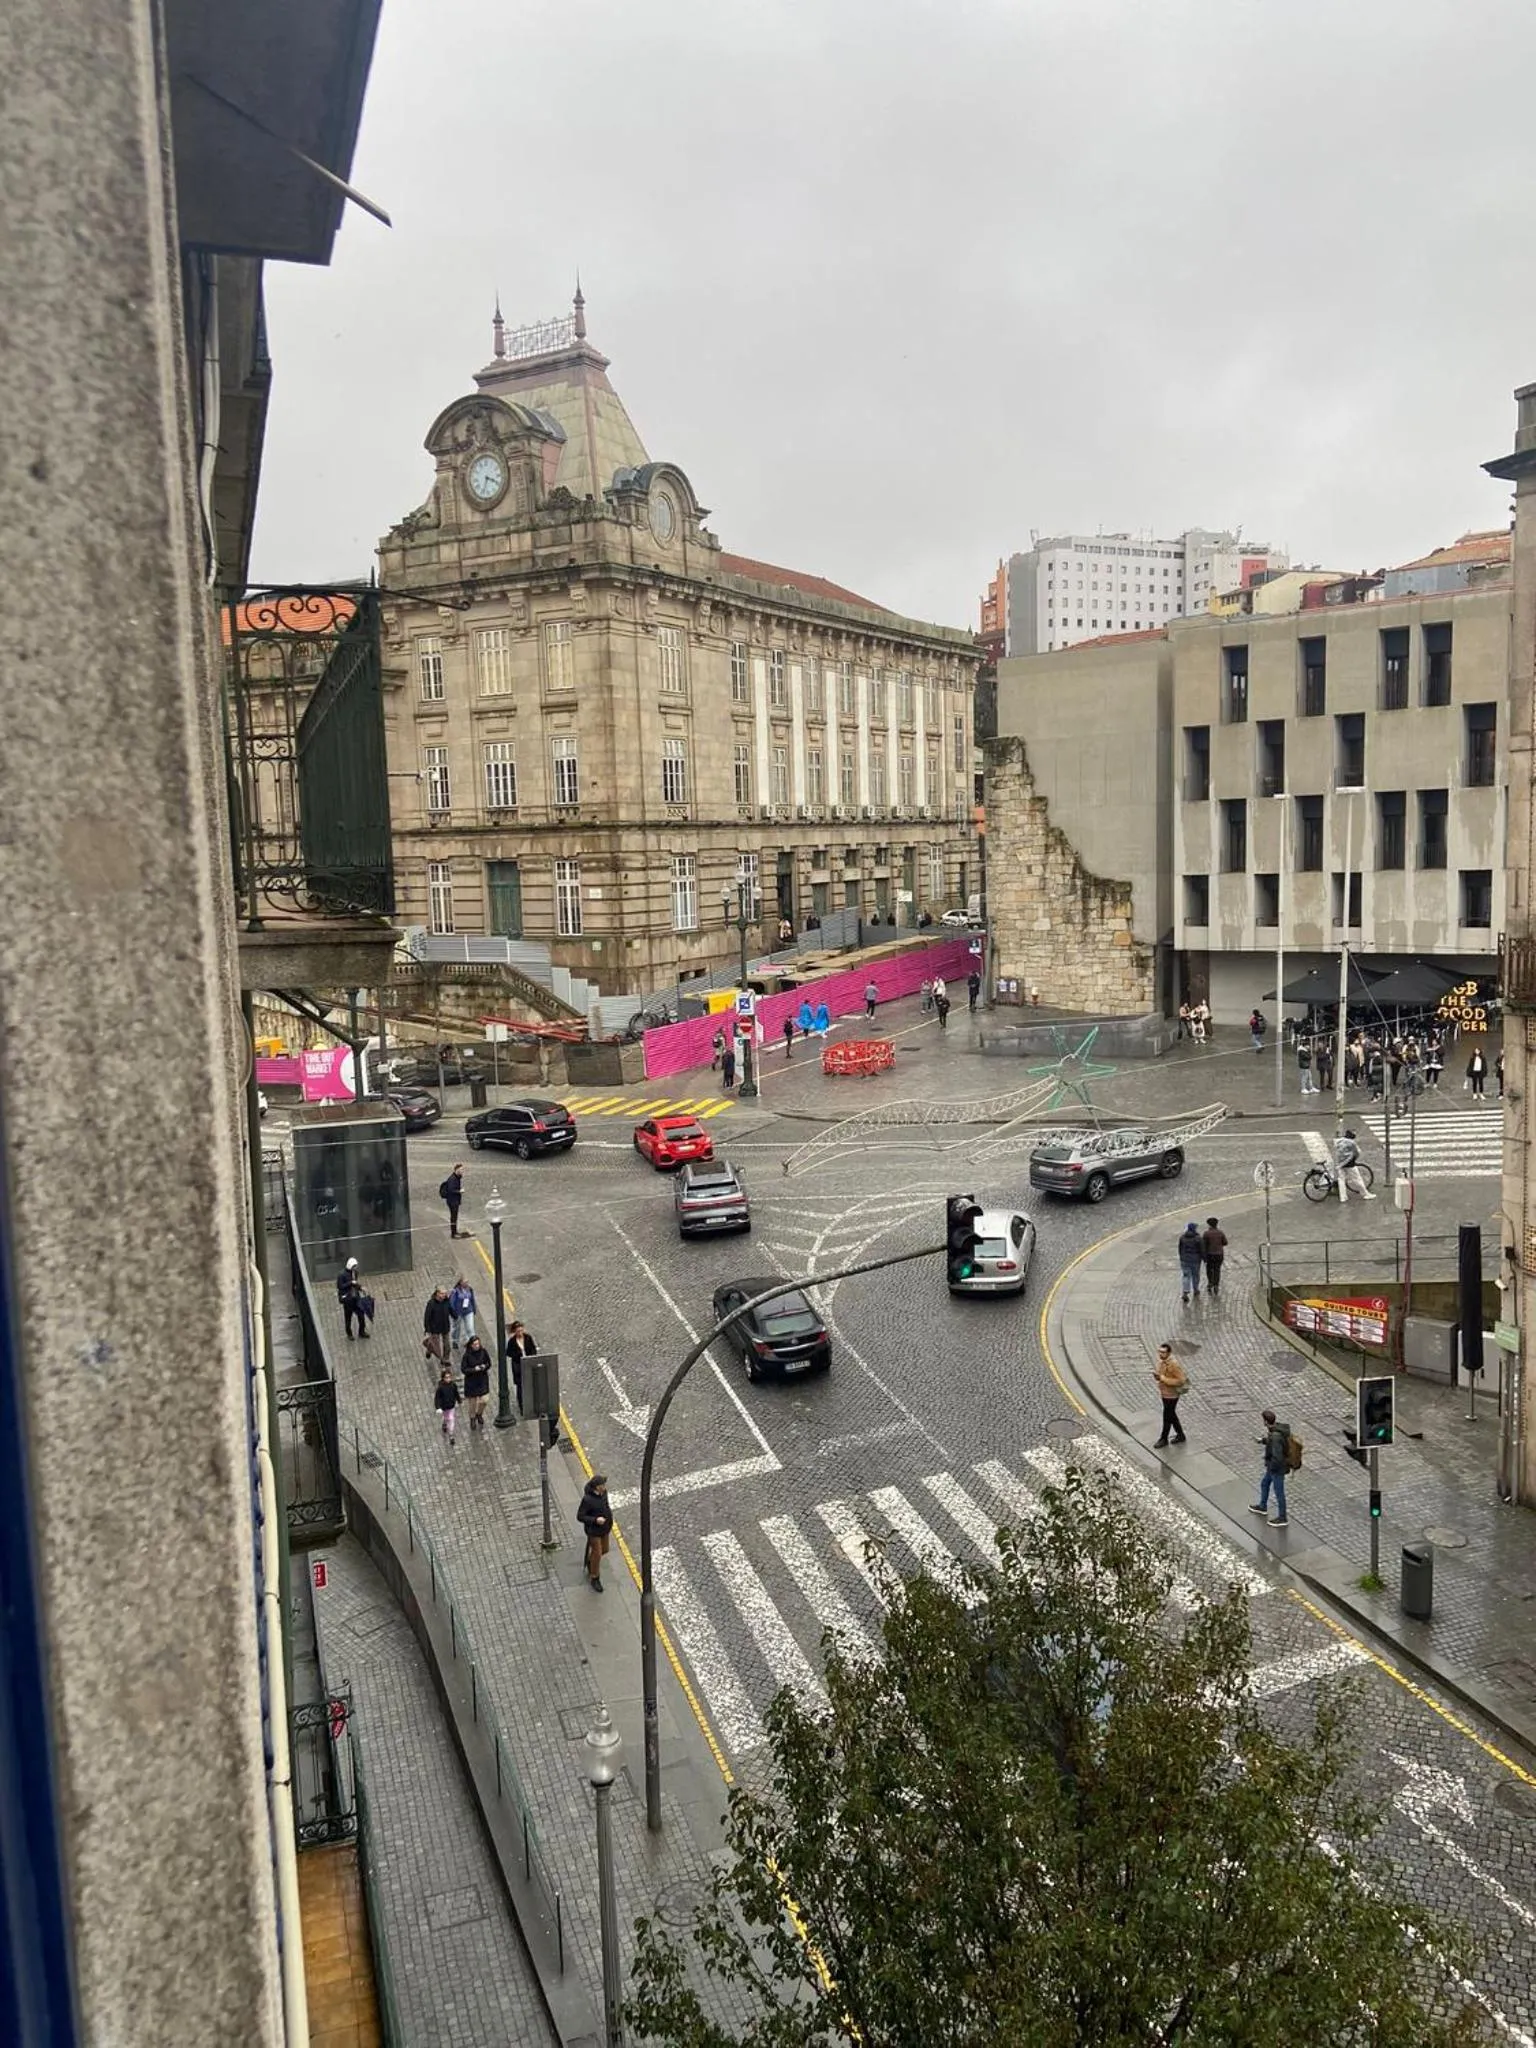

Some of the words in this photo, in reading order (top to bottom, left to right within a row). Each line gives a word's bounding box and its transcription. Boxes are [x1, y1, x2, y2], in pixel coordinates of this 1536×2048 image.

[1440, 995, 1467, 1006] THE
[1437, 1006, 1486, 1021] GOOD
[1357, 1309, 1385, 1318] TOURS
